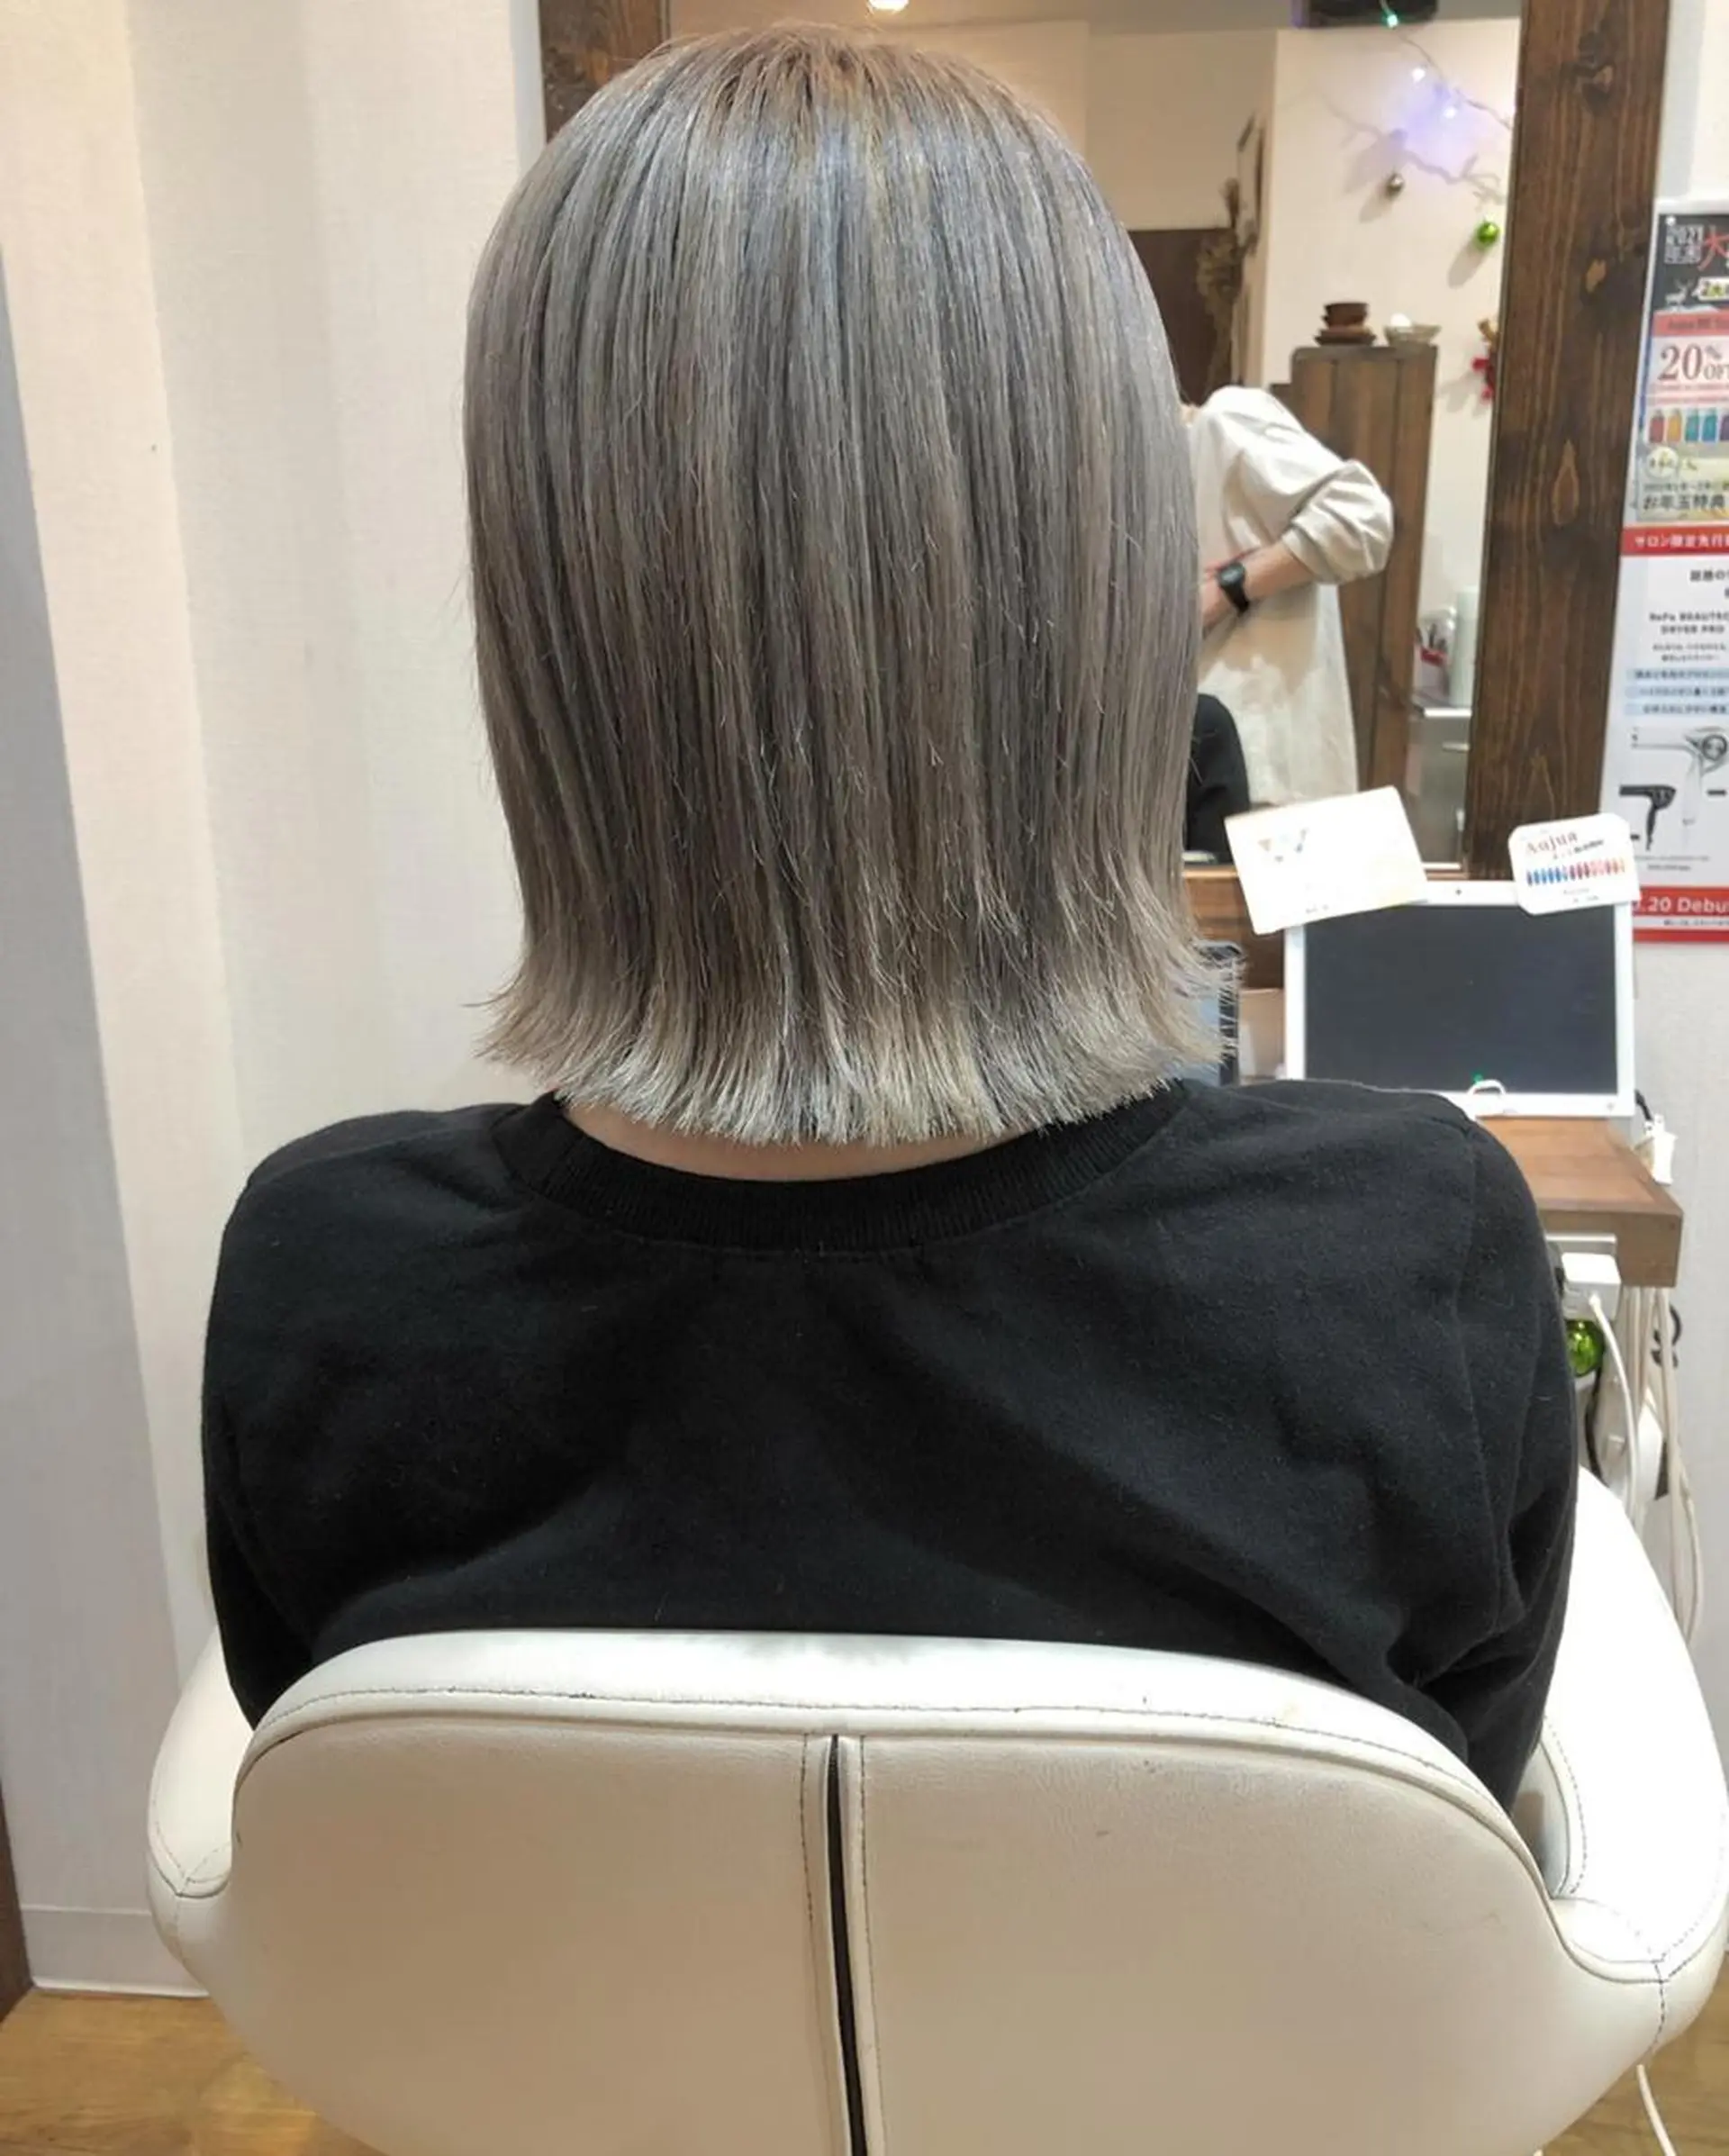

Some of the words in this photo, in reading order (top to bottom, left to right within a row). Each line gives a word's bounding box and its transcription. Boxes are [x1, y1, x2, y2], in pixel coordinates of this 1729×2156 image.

[1634, 533, 1729, 548] サロン限定先行
[1689, 569, 1729, 582] 話題の
